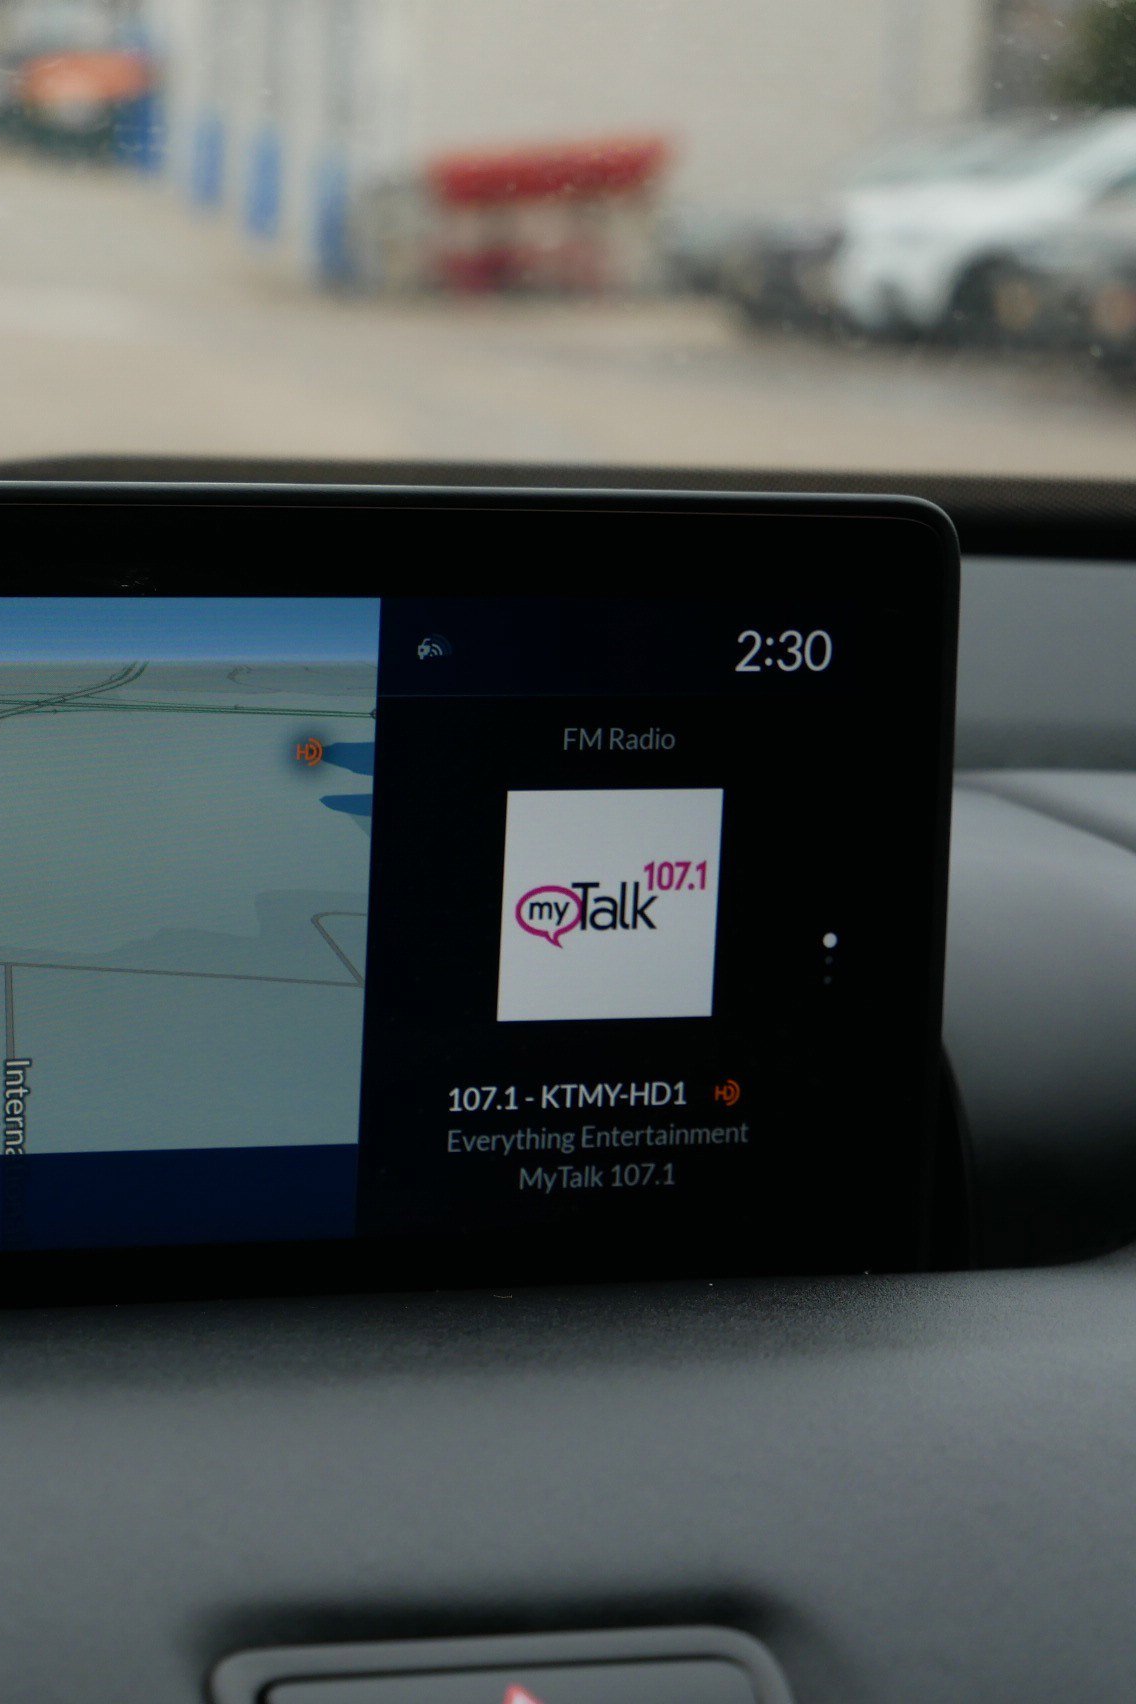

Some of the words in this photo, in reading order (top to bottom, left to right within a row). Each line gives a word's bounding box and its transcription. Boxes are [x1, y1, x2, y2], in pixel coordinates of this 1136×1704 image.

[734, 629, 834, 673] 2:30
[563, 728, 602, 752] FM
[608, 726, 676, 751] Radio
[643, 859, 707, 891] 107.1
[448, 1087, 518, 1112] 107.1
[541, 1082, 687, 1109] KTMY-HD1
[447, 1128, 575, 1155] Everything
[581, 1123, 749, 1149] Entertainment
[519, 1166, 604, 1194] MyTalk
[611, 1163, 675, 1187] 107.1
